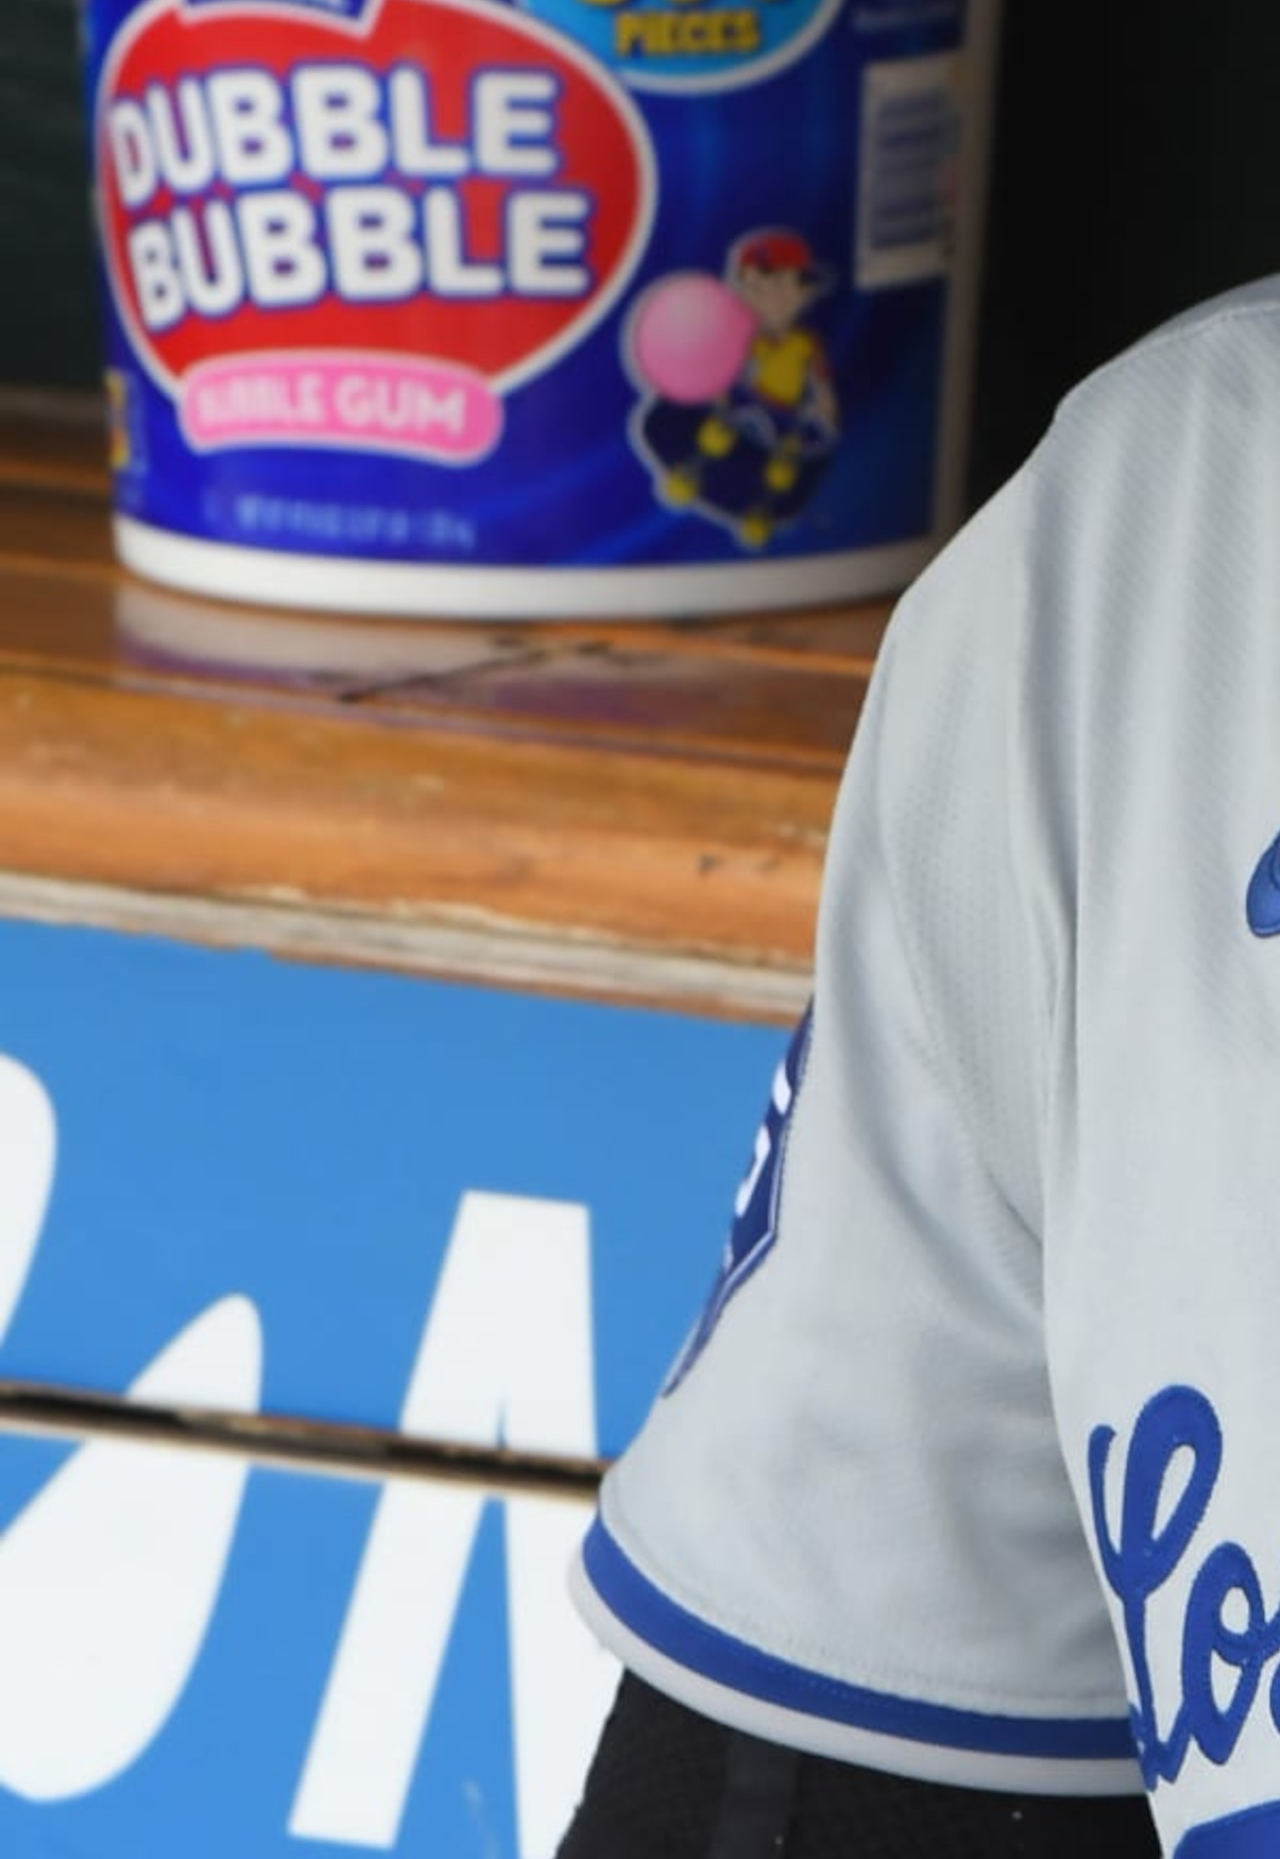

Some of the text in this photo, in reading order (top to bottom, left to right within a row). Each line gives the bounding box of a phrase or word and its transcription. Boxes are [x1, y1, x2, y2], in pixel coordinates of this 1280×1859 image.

[109, 61, 561, 210] DUBBLE
[127, 183, 592, 333] BUBBLE
[333, 376, 467, 436] GUM
